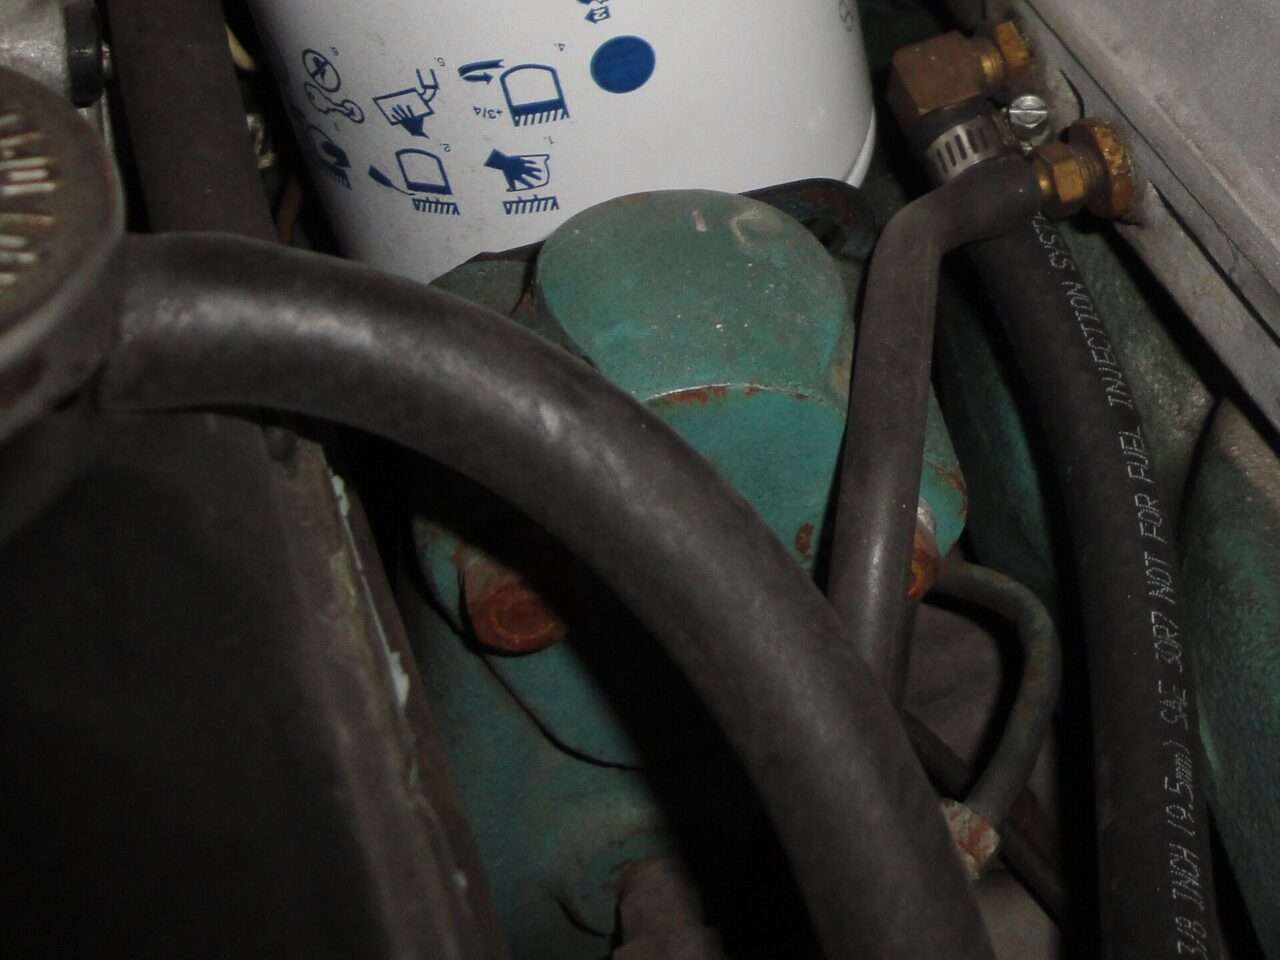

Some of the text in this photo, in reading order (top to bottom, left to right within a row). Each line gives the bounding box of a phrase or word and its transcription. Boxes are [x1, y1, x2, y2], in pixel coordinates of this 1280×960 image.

[1060, 280, 1135, 409] INJECTION
[1118, 426, 1155, 483] FUEL
[1134, 493, 1168, 544] FOR
[1144, 551, 1176, 604] NOT
[1157, 680, 1189, 730] SAE
[1168, 842, 1205, 911] INCH
